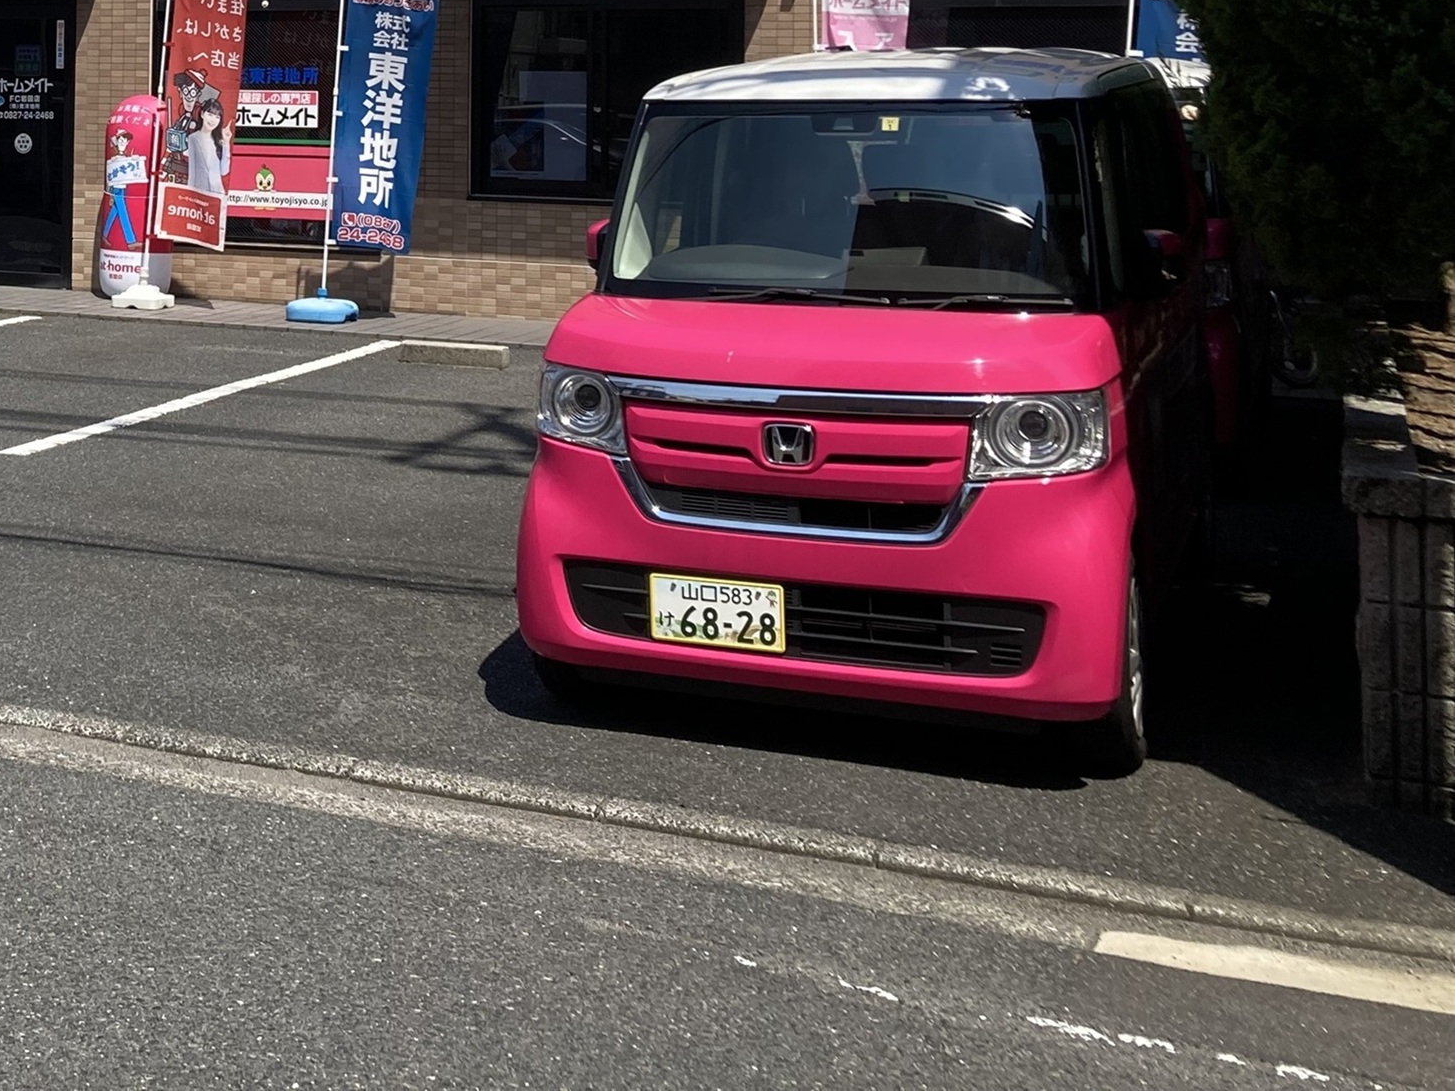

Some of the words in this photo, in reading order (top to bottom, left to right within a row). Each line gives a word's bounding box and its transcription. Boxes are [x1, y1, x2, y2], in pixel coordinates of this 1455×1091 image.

[374, 11, 411, 33] 株式
[373, 30, 409, 51] 会社
[236, 107, 316, 126] ホームメイト
[358, 52, 408, 209] 東洋地所
[228, 195, 328, 207] ttp://www.toyojisyo.co.jp
[680, 605, 777, 646] 68-28
